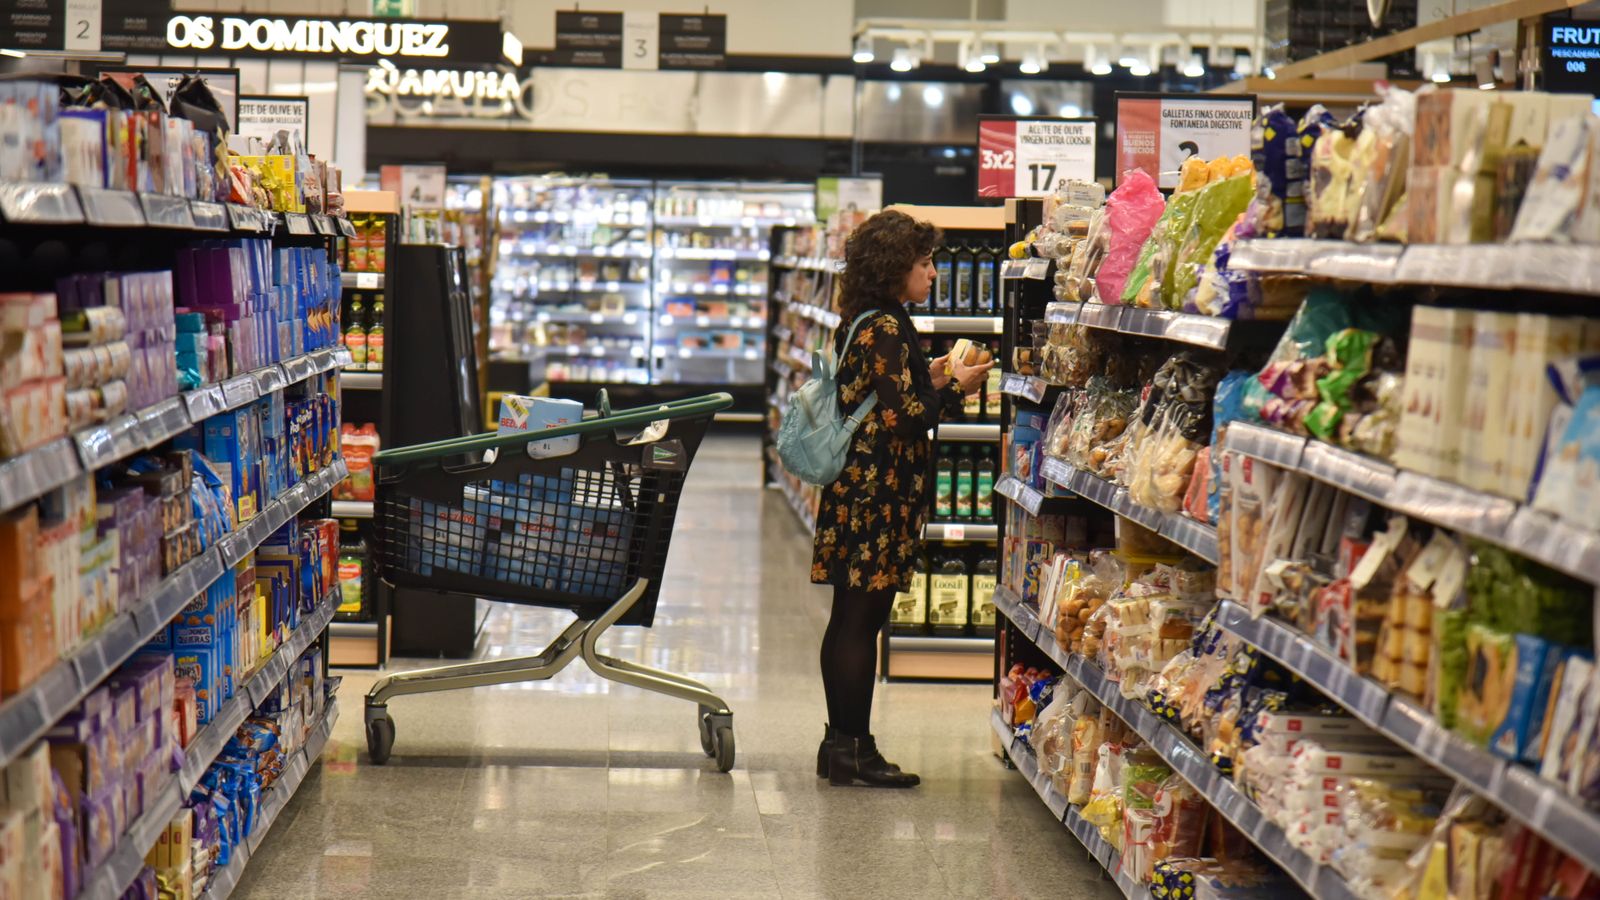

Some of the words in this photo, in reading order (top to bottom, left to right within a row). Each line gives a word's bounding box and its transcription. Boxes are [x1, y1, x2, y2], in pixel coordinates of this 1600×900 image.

[77, 20, 90, 39] 2
[166, 15, 213, 49] OS
[222, 18, 449, 57] DOMINGUEZ
[1552, 26, 1600, 45] FRUT
[634, 39, 647, 58] 3
[1162, 109, 1193, 119] GALLETAS
[1195, 109, 1213, 119] FINAS
[1215, 110, 1251, 120] CHOCOLATE
[1053, 125, 1061, 135] DE
[1170, 119, 1209, 129] FONTANEDA
[1210, 120, 1243, 130] DIGESTIVE
[1044, 135, 1064, 145] EXTRA
[981, 150, 1015, 170] 3x2
